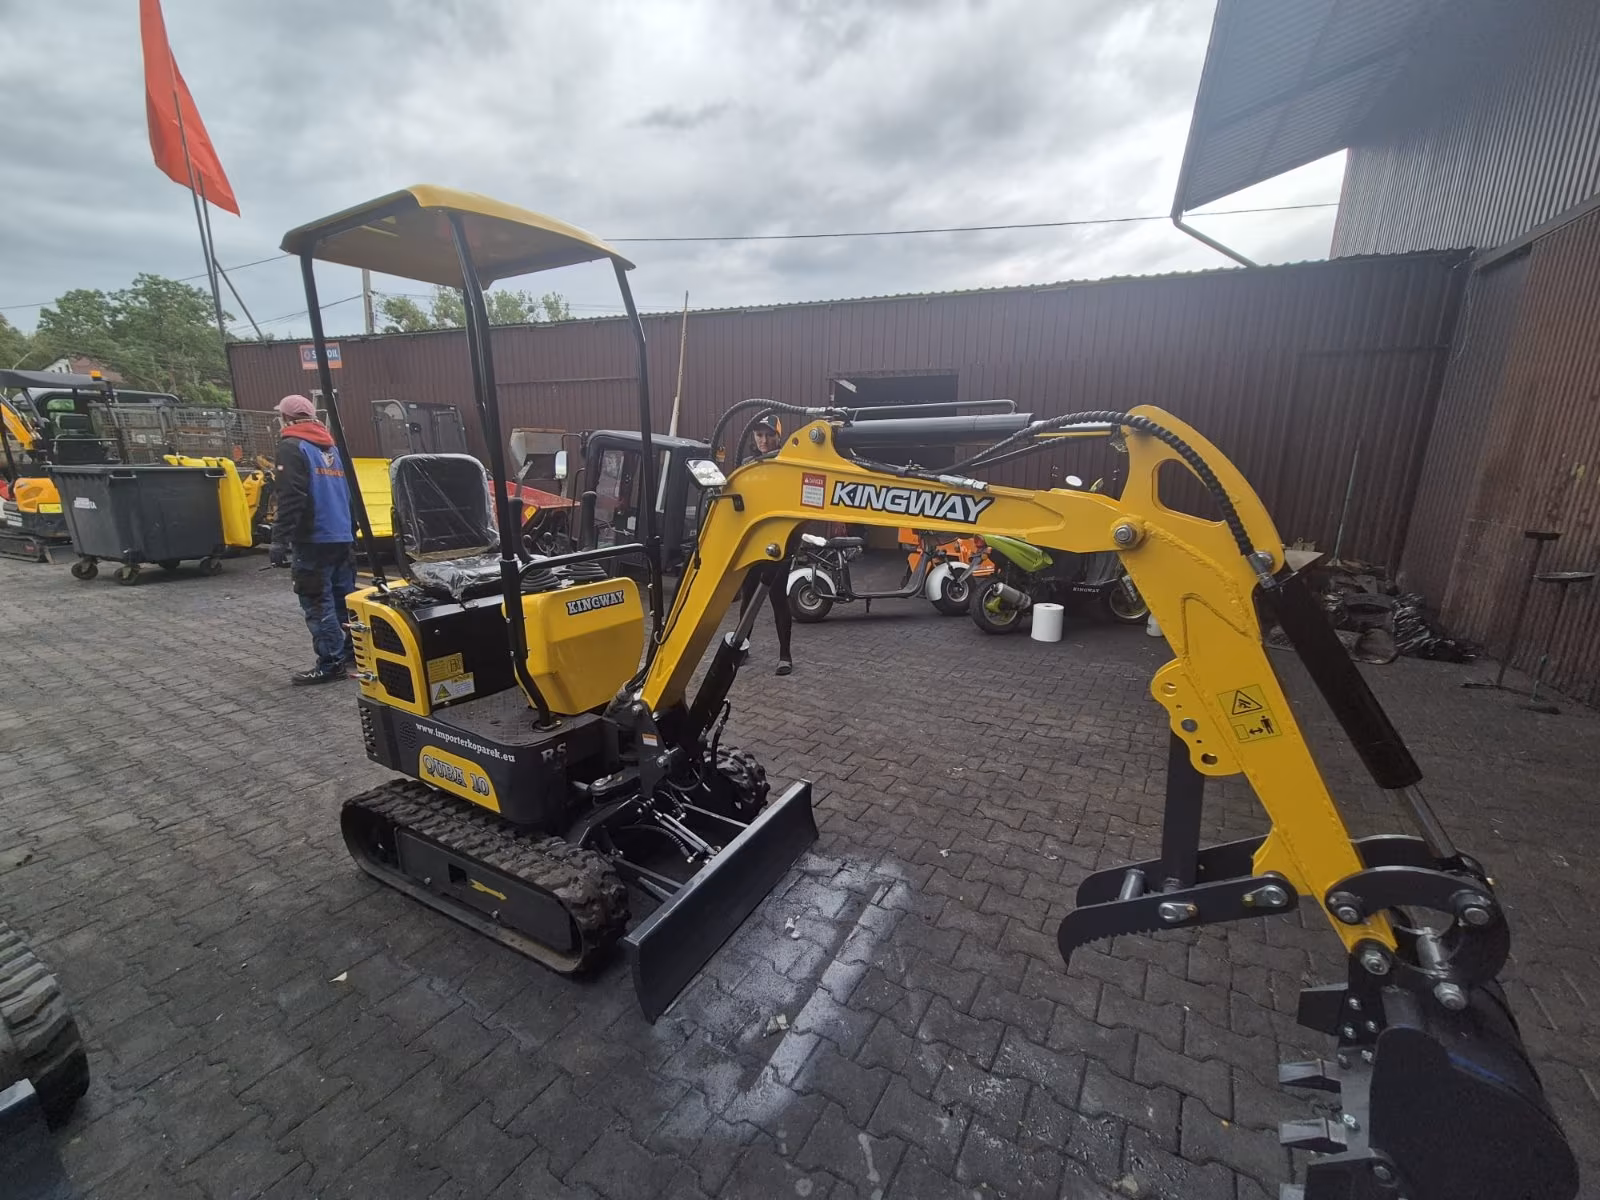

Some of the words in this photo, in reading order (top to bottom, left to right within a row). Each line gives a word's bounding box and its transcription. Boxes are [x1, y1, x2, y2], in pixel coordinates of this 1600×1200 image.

[311, 349, 338, 359] SOIL
[831, 481, 995, 524] KINGWAY
[567, 590, 624, 615] KINGWAY
[415, 722, 516, 763] www.importerkoparek.eu
[423, 754, 467, 788] QUBA
[470, 772, 490, 796] 10
